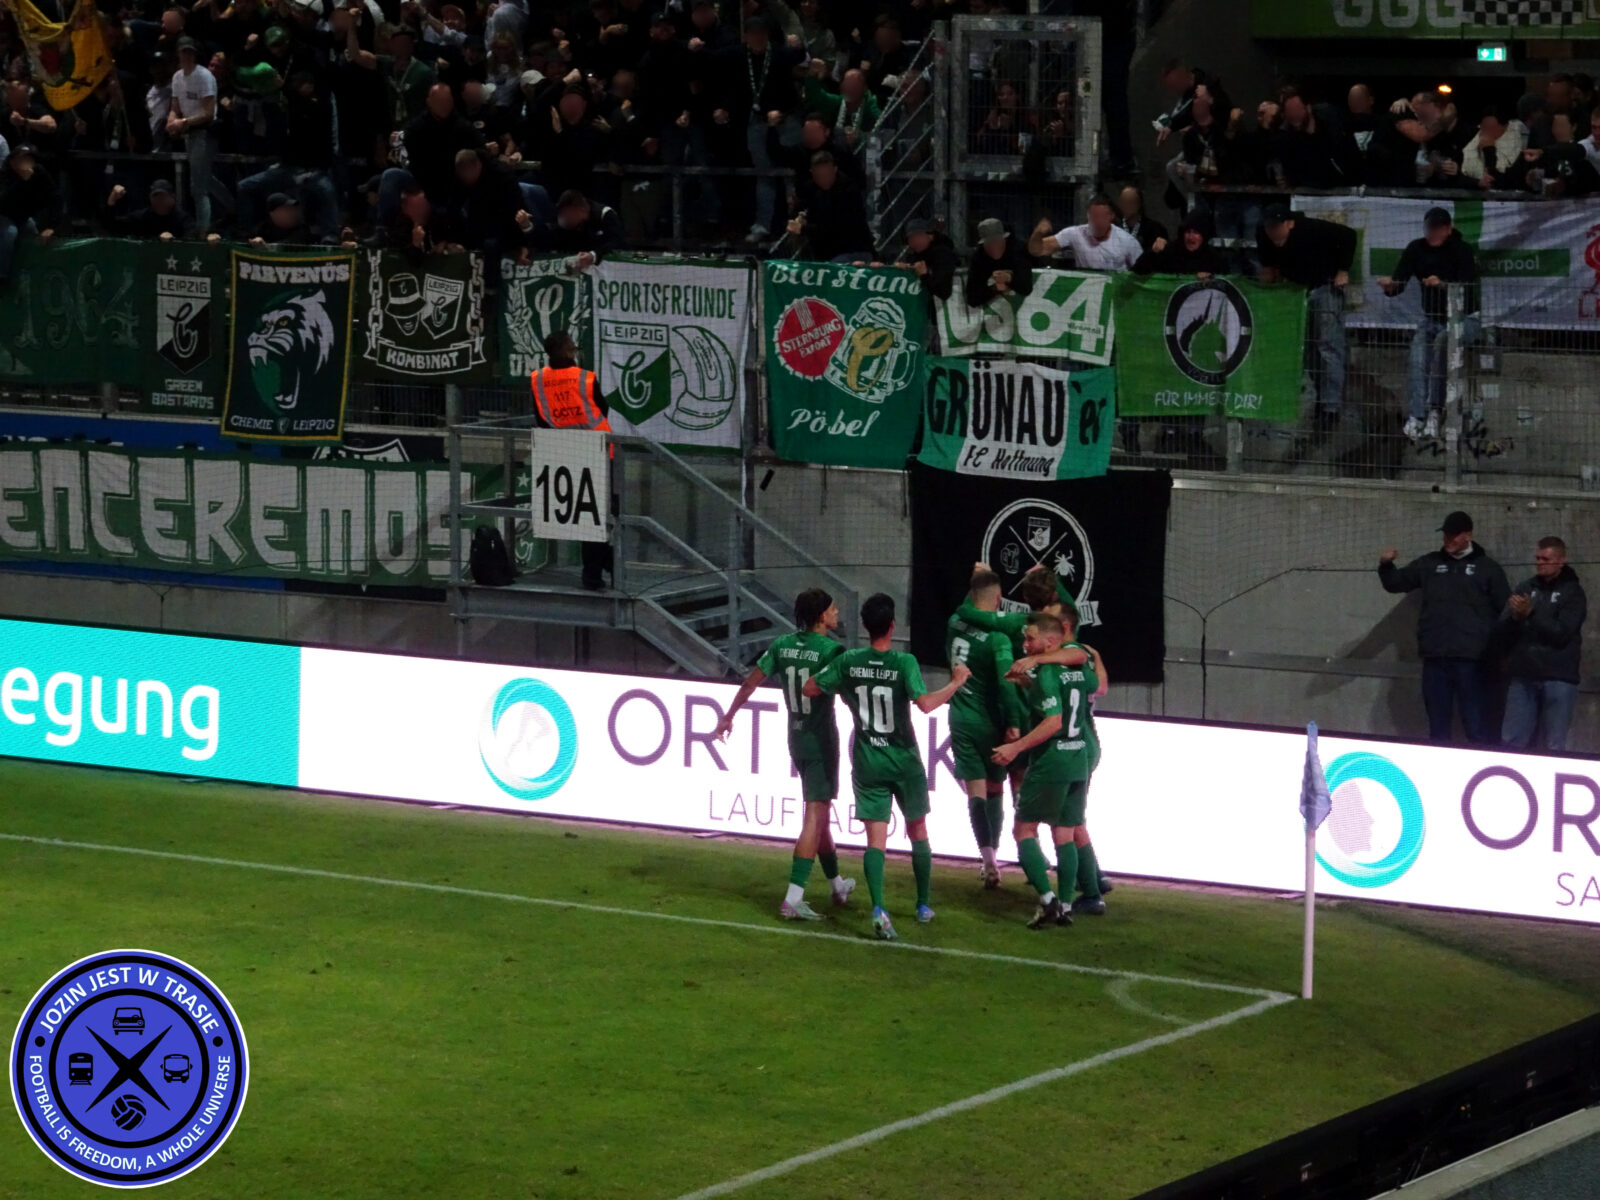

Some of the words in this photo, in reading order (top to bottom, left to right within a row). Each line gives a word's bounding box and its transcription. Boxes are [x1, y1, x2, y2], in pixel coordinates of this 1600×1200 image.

[160, 278, 208, 294] LEIPZIG
[598, 280, 737, 319] SPORTSFREUNDE
[14, 263, 140, 349] 1964
[604, 326, 664, 341] LEIPZIG
[781, 318, 842, 354] STERNBURG
[386, 348, 459, 369] KOMBINAT
[165, 379, 203, 392] GREEN
[1155, 390, 1181, 407] FÜR
[152, 393, 215, 410] BASTARDS
[230, 416, 274, 430] CHEMIE
[292, 419, 336, 431] LEIPZIG
[786, 408, 880, 438] Pöbel
[990, 447, 1055, 477] Hoffnung
[536, 465, 601, 526] 19A
[849, 666, 875, 677] CHEMIE
[785, 666, 811, 715] 11
[1, 667, 221, 761] egung
[854, 685, 895, 733] 10
[1067, 688, 1081, 738] 2
